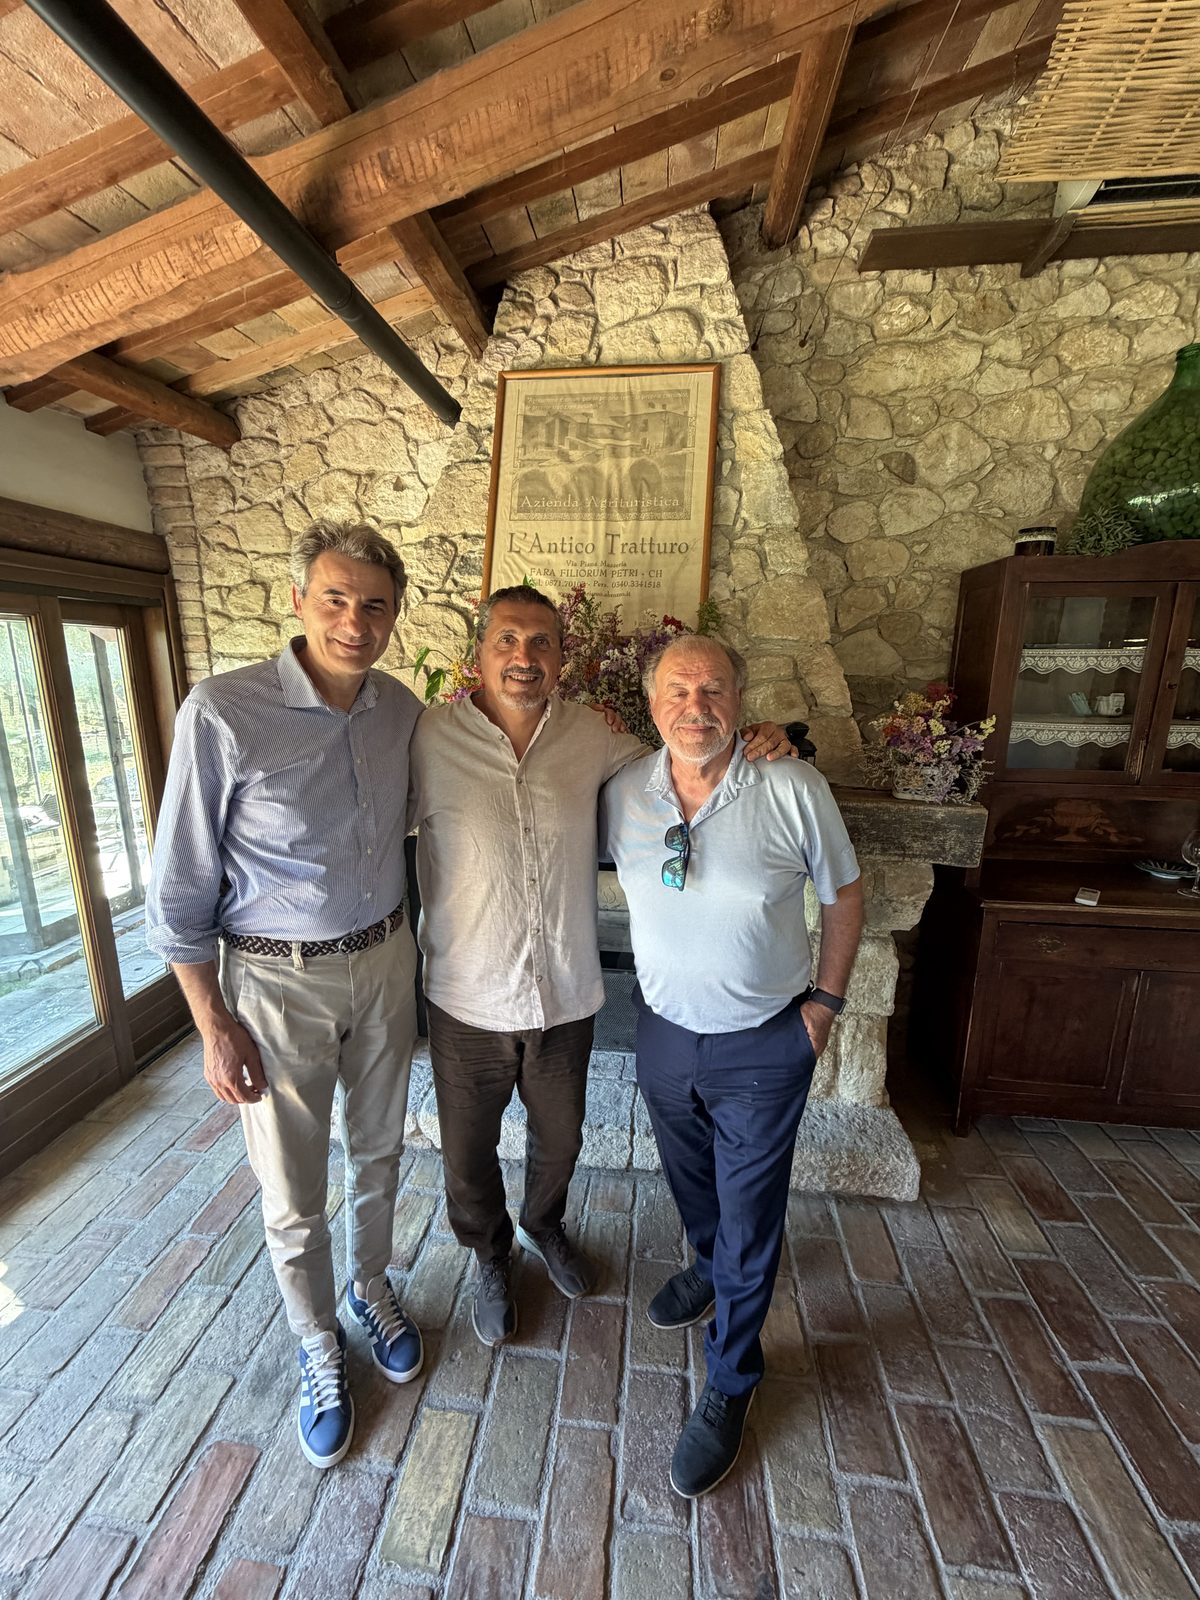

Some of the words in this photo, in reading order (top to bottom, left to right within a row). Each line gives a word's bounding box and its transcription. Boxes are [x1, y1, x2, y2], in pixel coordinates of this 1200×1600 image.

[520, 494, 579, 508] Azienda
[586, 495, 680, 510] Agrituristica
[507, 532, 595, 554] L'Antico
[605, 532, 689, 555] Tratturo
[566, 560, 578, 568] Via
[530, 568, 556, 577] FARA
[560, 569, 607, 578] FILIORUM
[611, 569, 638, 578] PETRI
[648, 569, 663, 578] CH
